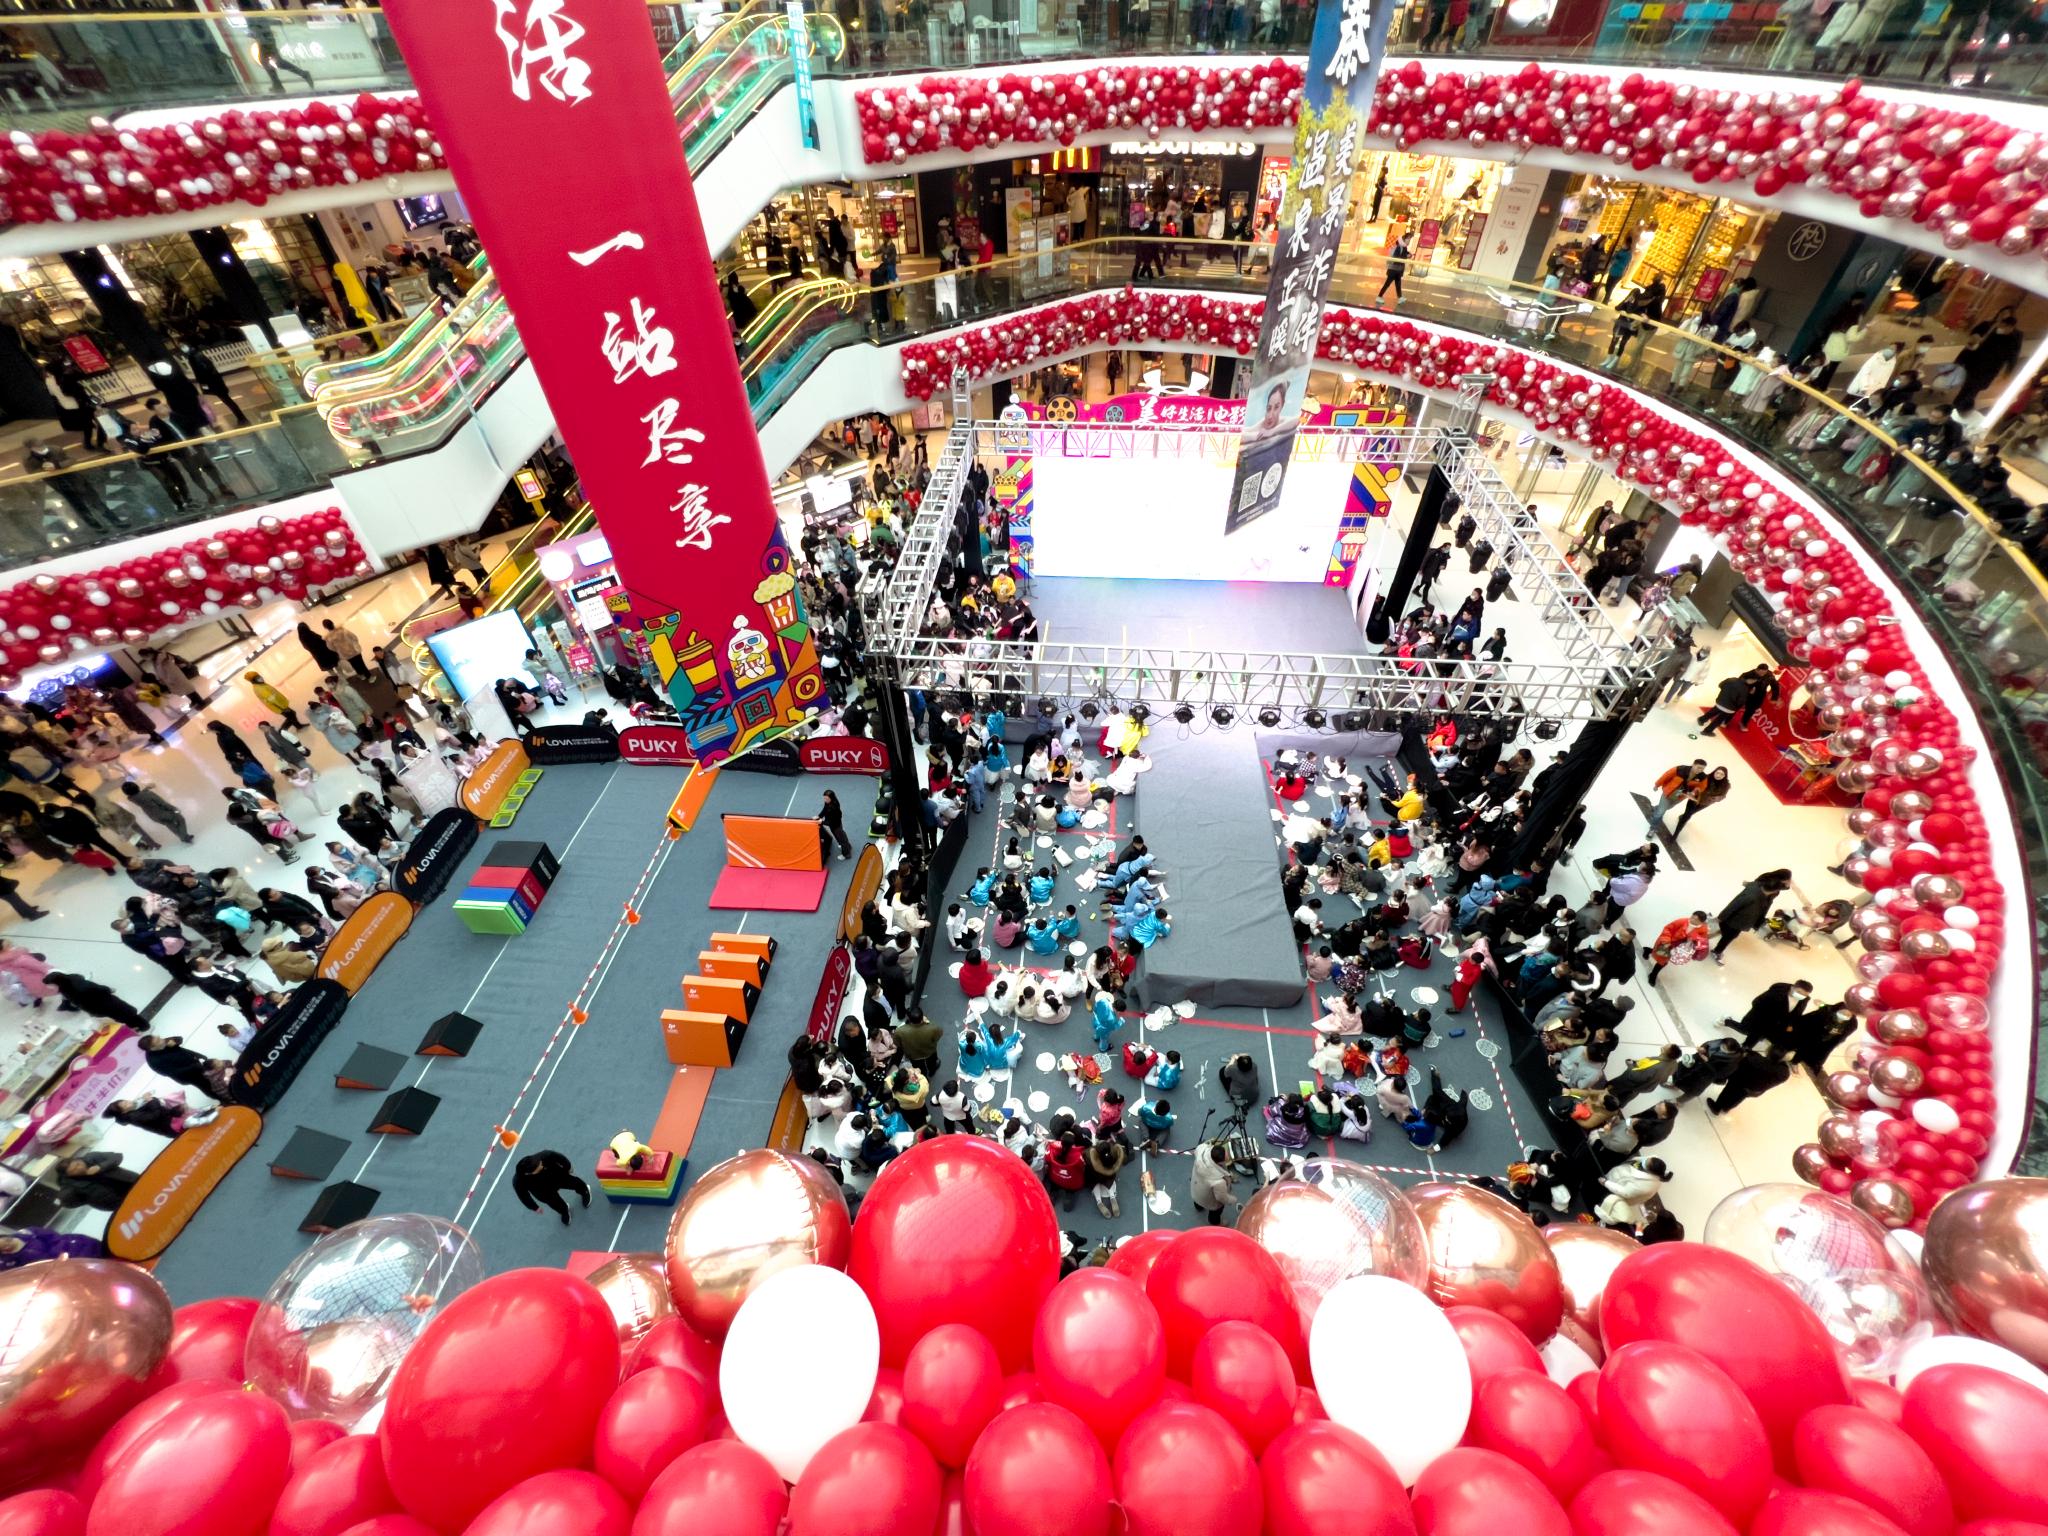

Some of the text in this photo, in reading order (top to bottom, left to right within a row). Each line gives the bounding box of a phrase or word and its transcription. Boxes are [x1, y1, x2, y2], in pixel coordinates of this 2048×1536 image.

[1751, 708, 1780, 742] 2022
[628, 739, 678, 753] PUKY
[810, 750, 862, 764] PUKY
[816, 978, 838, 1042] PUKY
[261, 1034, 294, 1068] LOVA
[144, 1173, 189, 1215] LOVA
